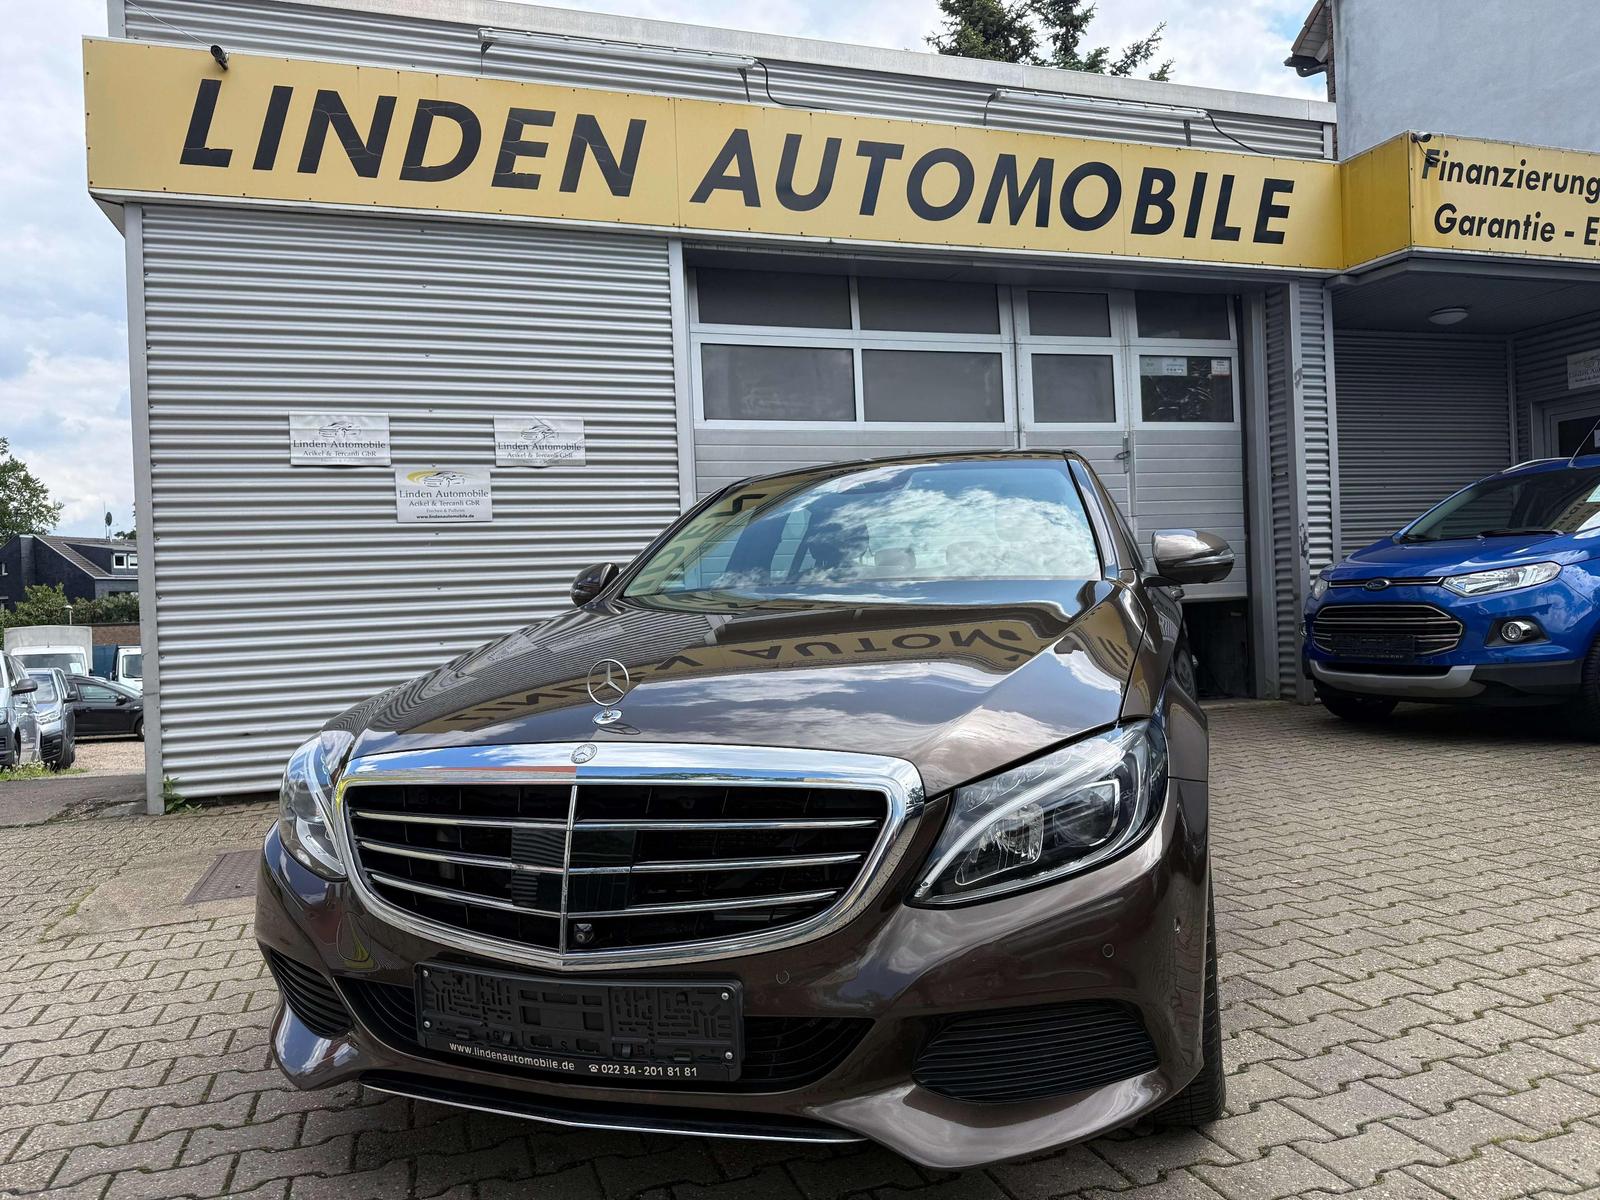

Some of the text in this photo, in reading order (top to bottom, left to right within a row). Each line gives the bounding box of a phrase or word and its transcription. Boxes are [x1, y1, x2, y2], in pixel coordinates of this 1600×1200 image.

[179, 78, 1296, 246] LINDEN AUTOMOBILE
[1421, 148, 1600, 205] Finanzierung
[1434, 202, 1556, 243] Garantie
[1583, 216, 1600, 247] E
[293, 439, 386, 450] Linden Automobile
[497, 442, 582, 452] Linden Automobile
[399, 489, 489, 499] Linden Automobile
[449, 1042, 575, 1071] www.lindenautomobile.de
[601, 1064, 621, 1075] 022
[667, 1067, 680, 1077] 81
[684, 1067, 697, 1077] 81
